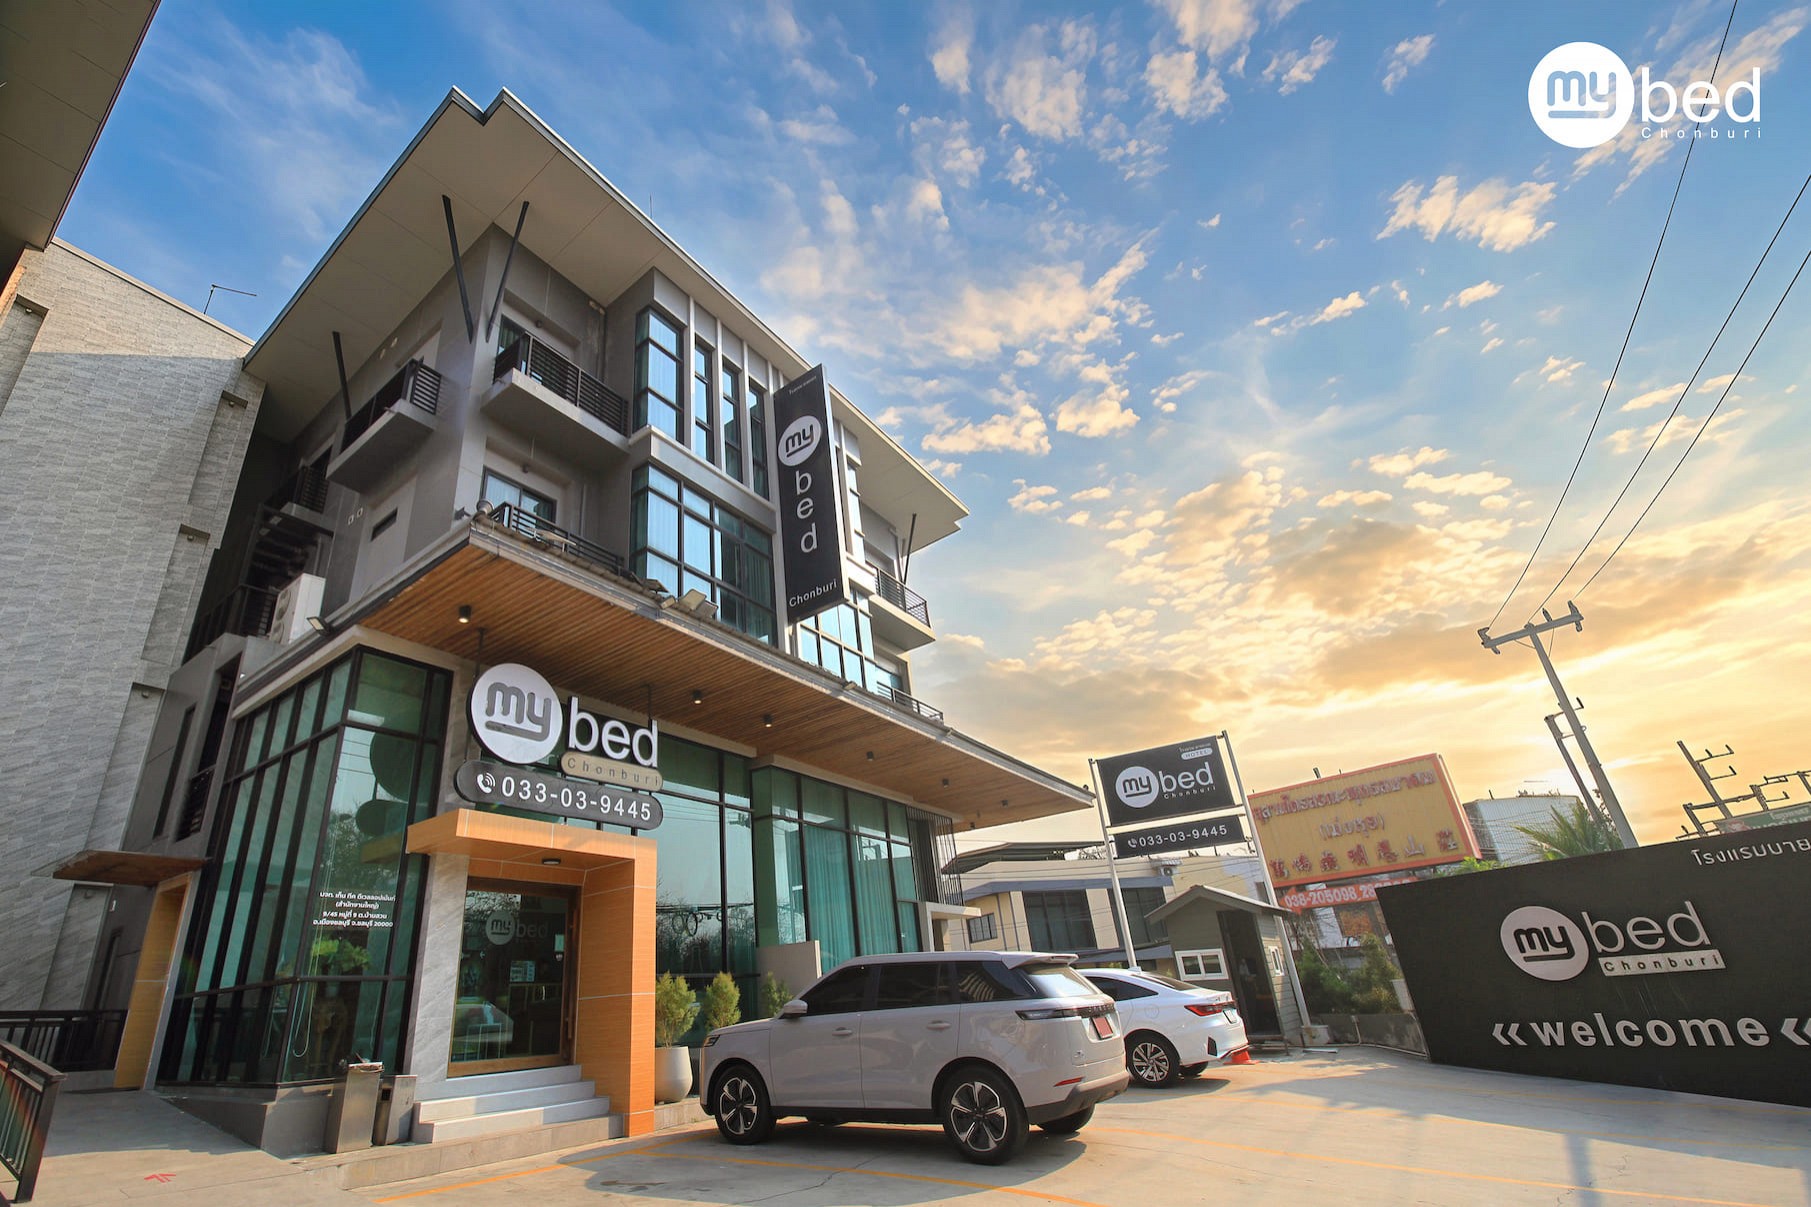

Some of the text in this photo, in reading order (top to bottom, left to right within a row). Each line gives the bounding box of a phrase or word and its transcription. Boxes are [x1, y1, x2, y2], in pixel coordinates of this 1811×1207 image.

[785, 423, 814, 459] my
[788, 578, 838, 607] Chonburi
[485, 681, 659, 768] my bed
[566, 757, 660, 787] Chonburi
[1122, 761, 1214, 798] my bed
[501, 776, 651, 821] 033-03-9445
[1163, 786, 1216, 800] Chonburi
[1139, 824, 1228, 847] 033-03-9445
[335, 900, 380, 910] (สำนักงานใหญ่)
[374, 920, 394, 928] 20000
[490, 919, 512, 936] my
[1513, 900, 1712, 963] my bed
[1603, 953, 1722, 972] Chonburi
[1529, 1012, 1771, 1047] welcome
